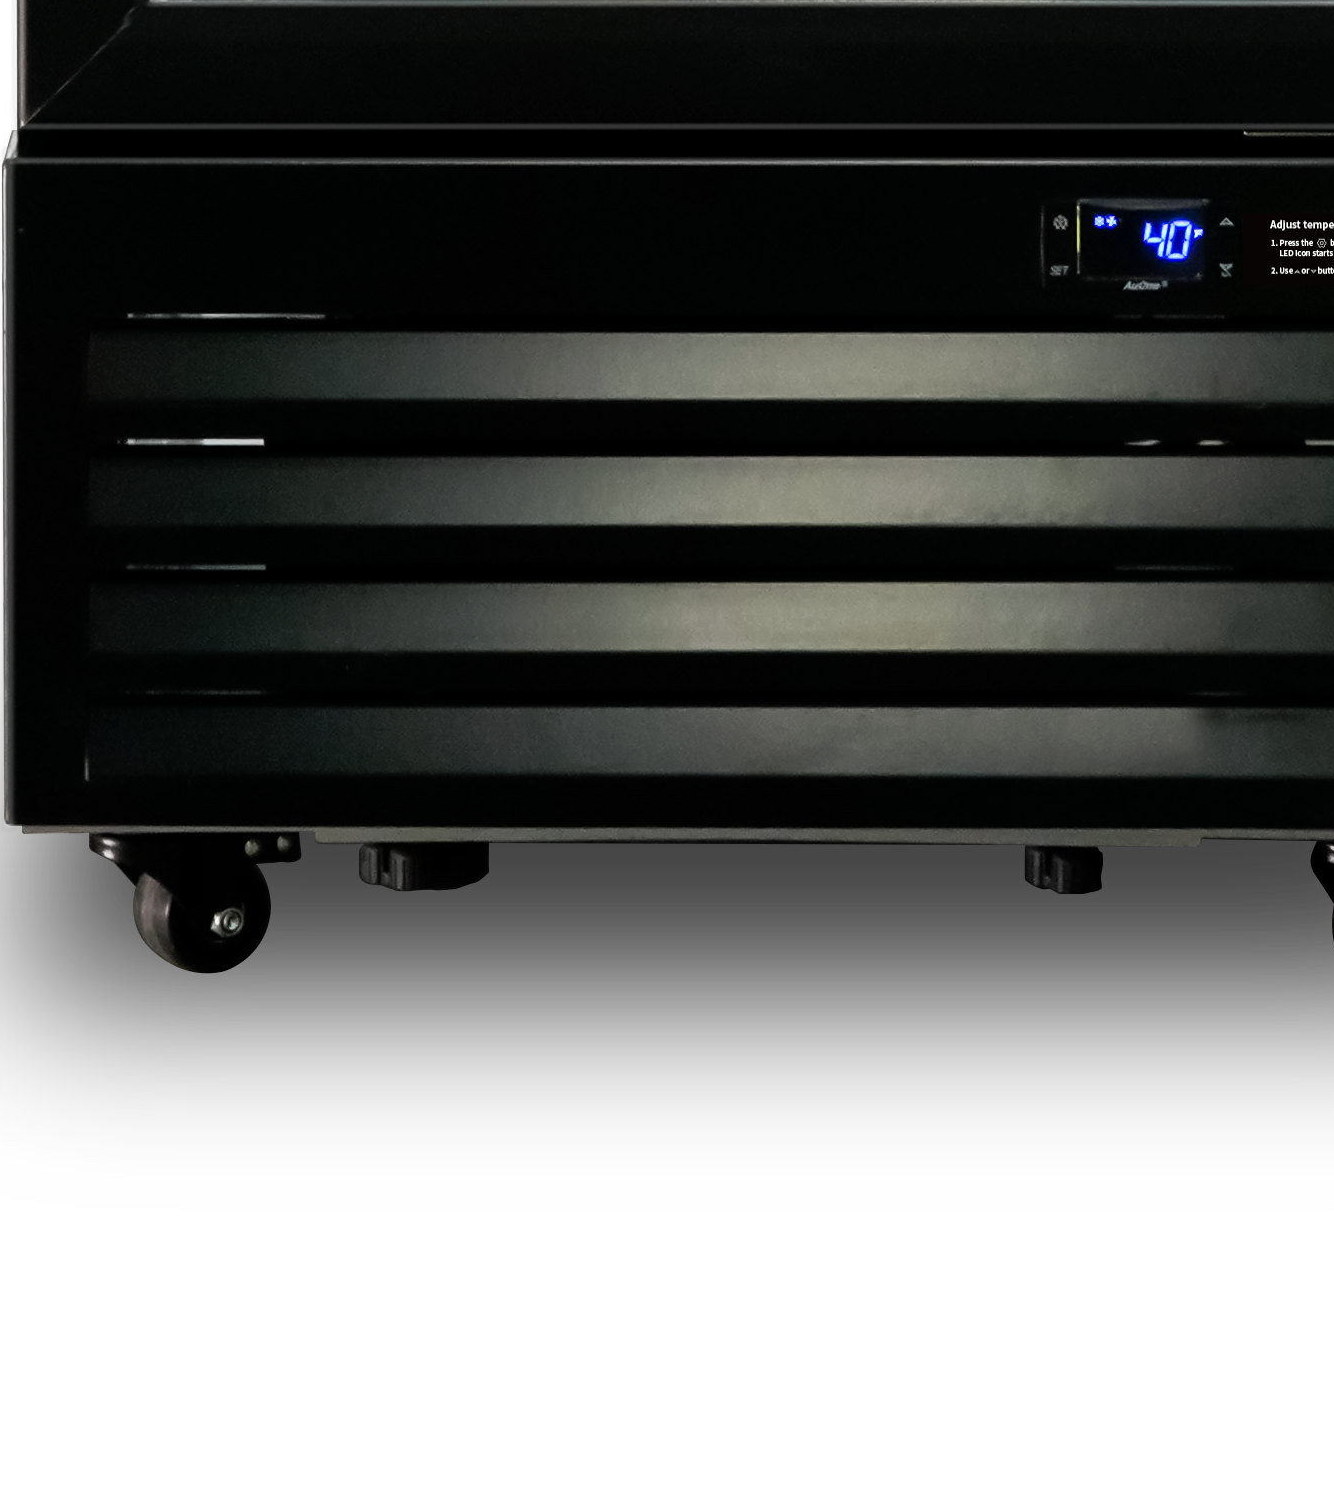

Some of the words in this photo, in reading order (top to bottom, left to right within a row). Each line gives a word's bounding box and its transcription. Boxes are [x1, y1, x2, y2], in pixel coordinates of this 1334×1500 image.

[1269, 220, 1301, 231] Adjust
[1142, 219, 1193, 260] 40
[1271, 239, 1278, 247] 1.
[1279, 239, 1300, 247] Press
[1301, 239, 1314, 247] the
[1279, 249, 1295, 257] LED
[1312, 249, 1334, 257] starts
[1271, 267, 1278, 275] 2.
[1279, 267, 1294, 275] Use
